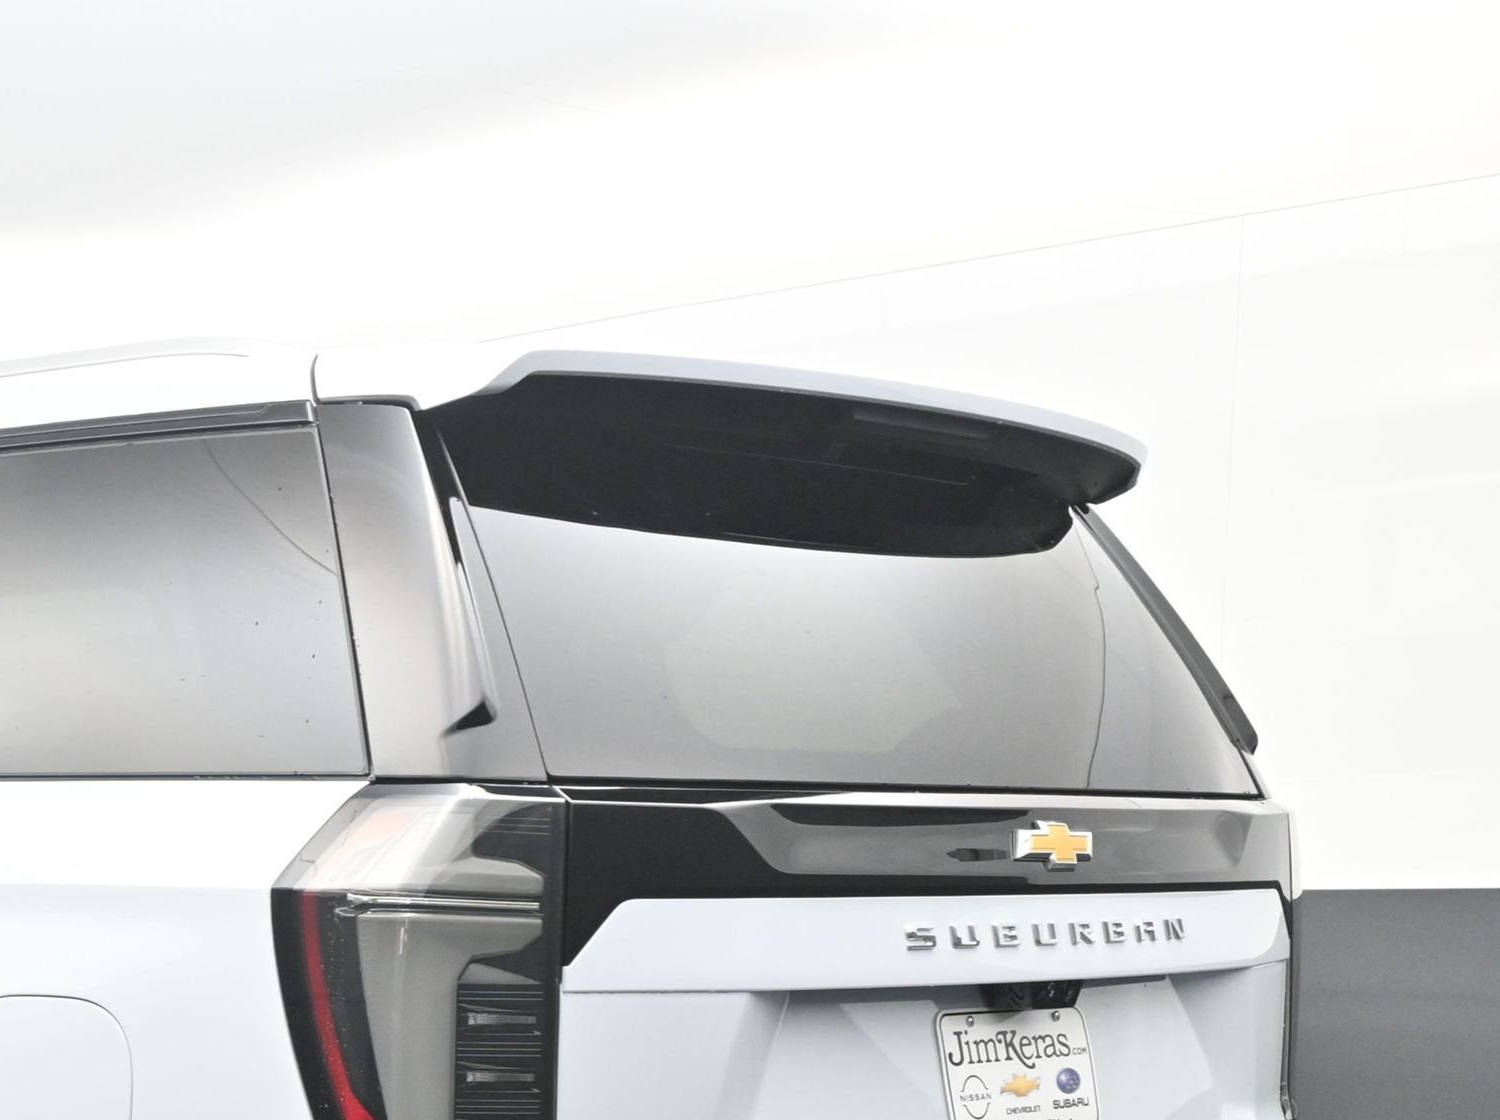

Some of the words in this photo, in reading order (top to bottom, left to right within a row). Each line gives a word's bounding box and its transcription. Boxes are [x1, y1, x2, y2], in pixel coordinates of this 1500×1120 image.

[905, 918, 1186, 950] SUBURBAN
[960, 1093, 992, 1103] NISSAN
[1052, 1097, 1089, 1110] SUBARU
[1006, 1104, 1042, 1115] CHEVROLET
